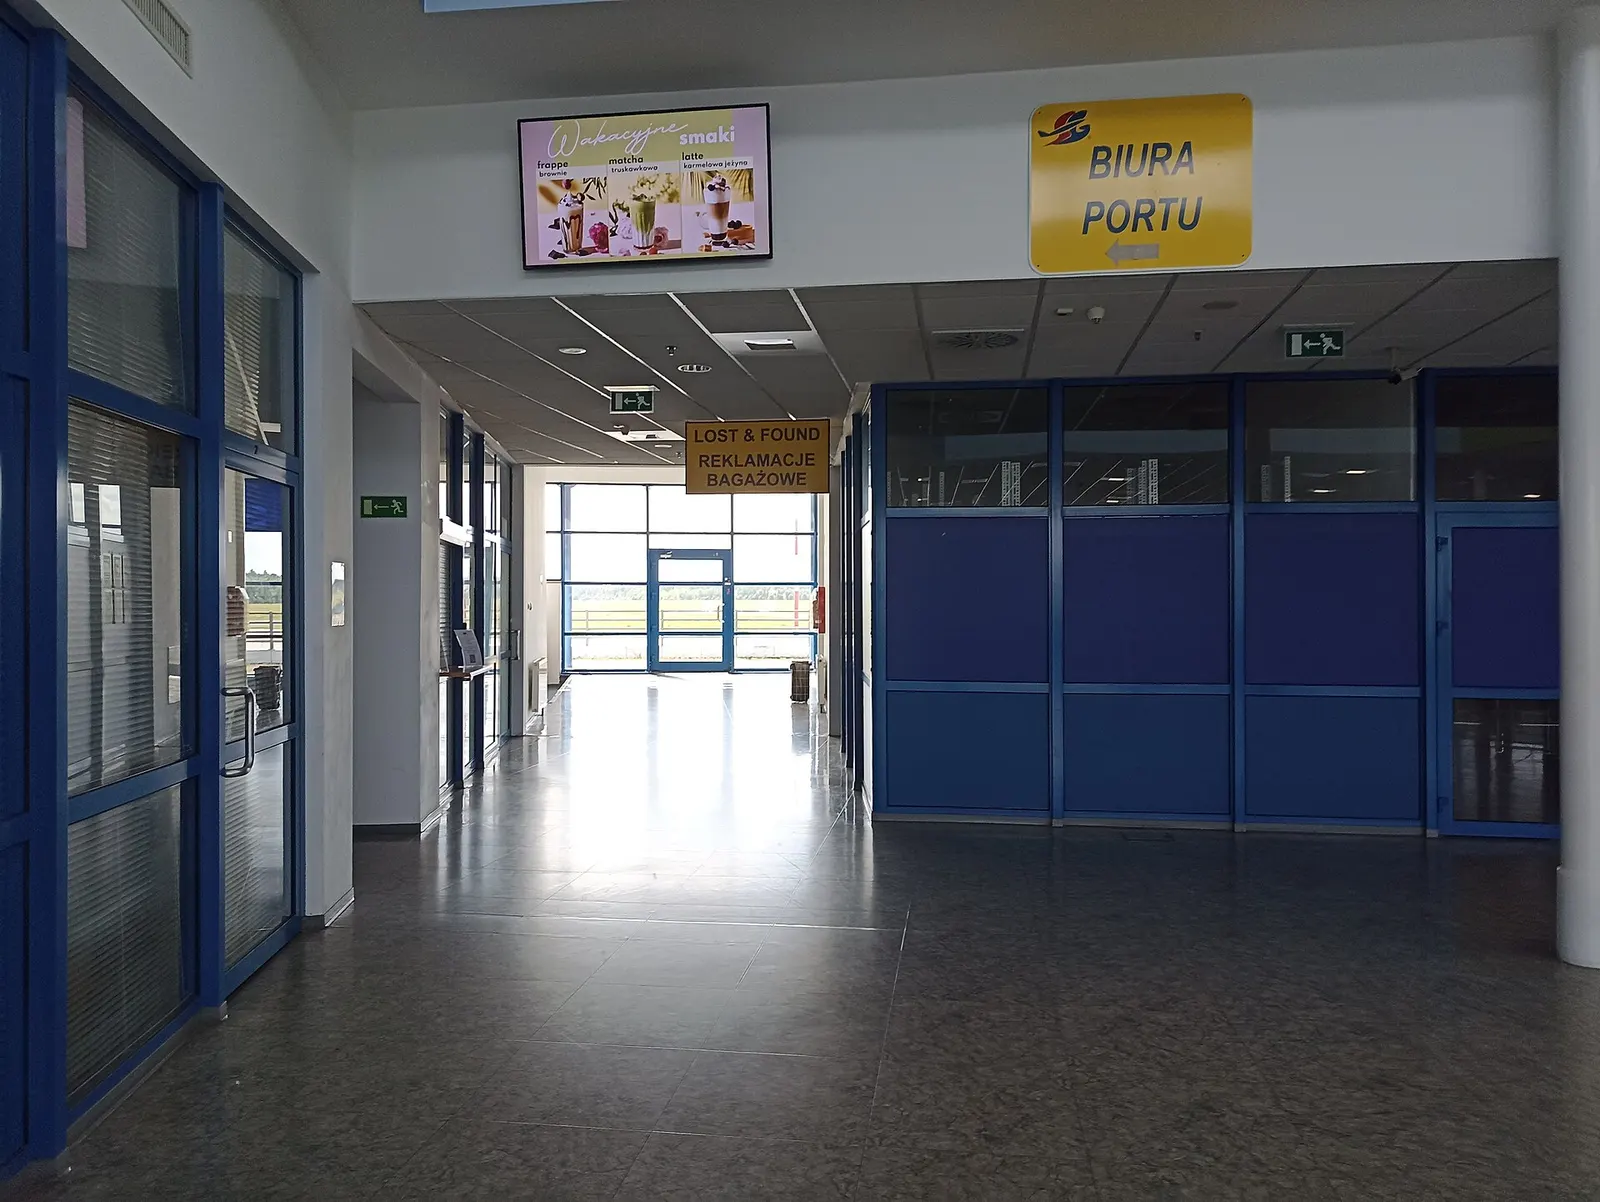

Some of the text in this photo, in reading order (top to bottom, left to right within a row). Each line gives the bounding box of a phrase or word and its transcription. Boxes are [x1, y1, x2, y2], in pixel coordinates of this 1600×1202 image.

[547, 119, 735, 158] Wakacyjne smaki
[608, 154, 644, 165] matcha
[681, 151, 704, 161] latte
[1088, 140, 1195, 180] BIURA
[537, 160, 569, 170] frappe
[611, 165, 659, 173] truskawkowa
[683, 160, 748, 169] karmelowa jeżyna
[1081, 196, 1203, 235] PORTU
[694, 427, 820, 443] LOST & FOUND
[699, 452, 816, 468] REKLAMACJE
[706, 469, 807, 487] BAGAŻOWE
